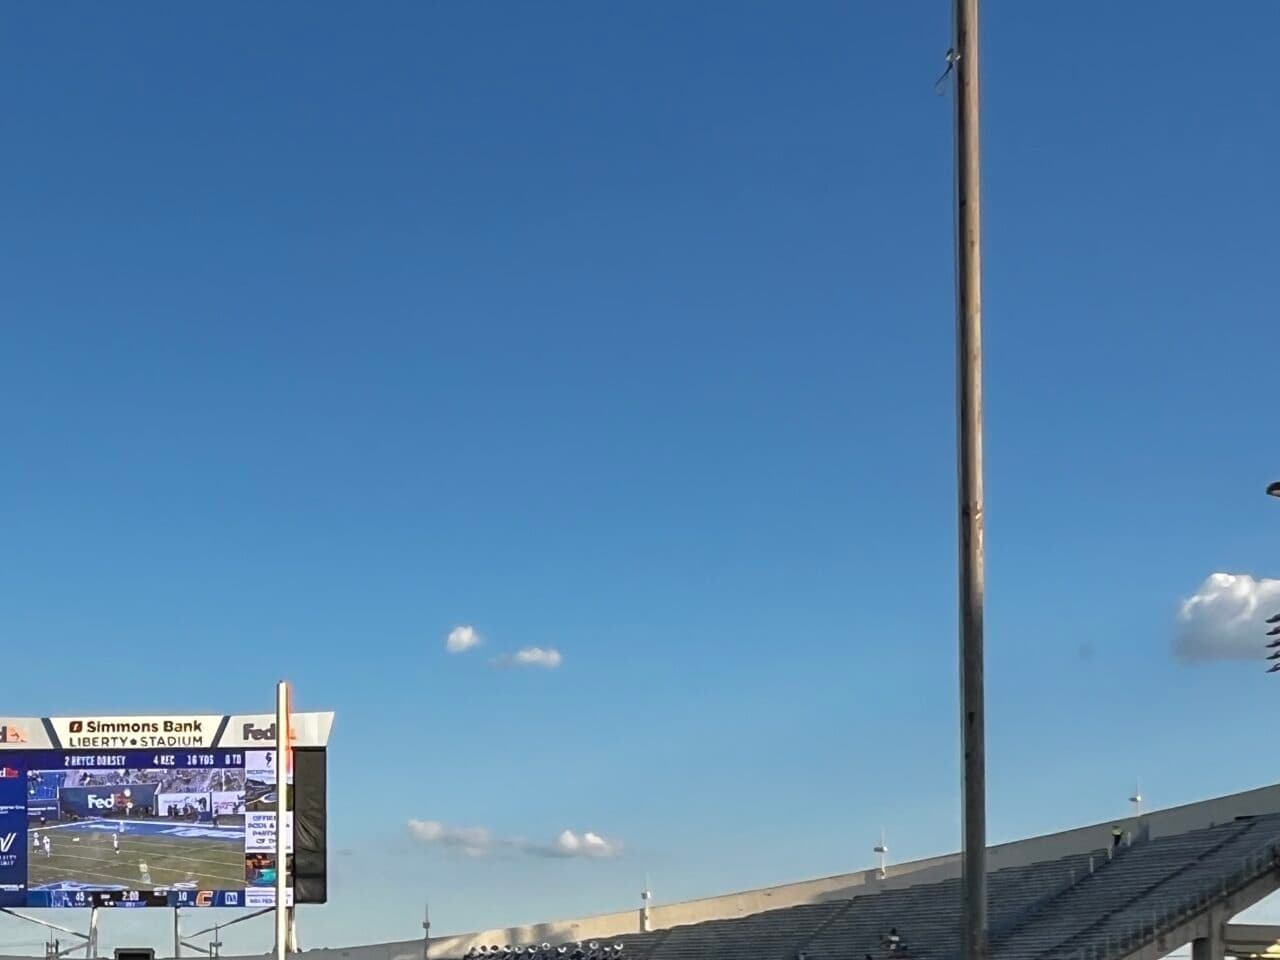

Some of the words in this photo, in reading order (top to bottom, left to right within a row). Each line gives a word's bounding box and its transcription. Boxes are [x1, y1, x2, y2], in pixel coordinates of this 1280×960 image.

[87, 720, 158, 733] Simmons
[164, 719, 202, 732] Bank
[70, 736, 128, 748] LIBERTY
[140, 736, 202, 747] STADIUM
